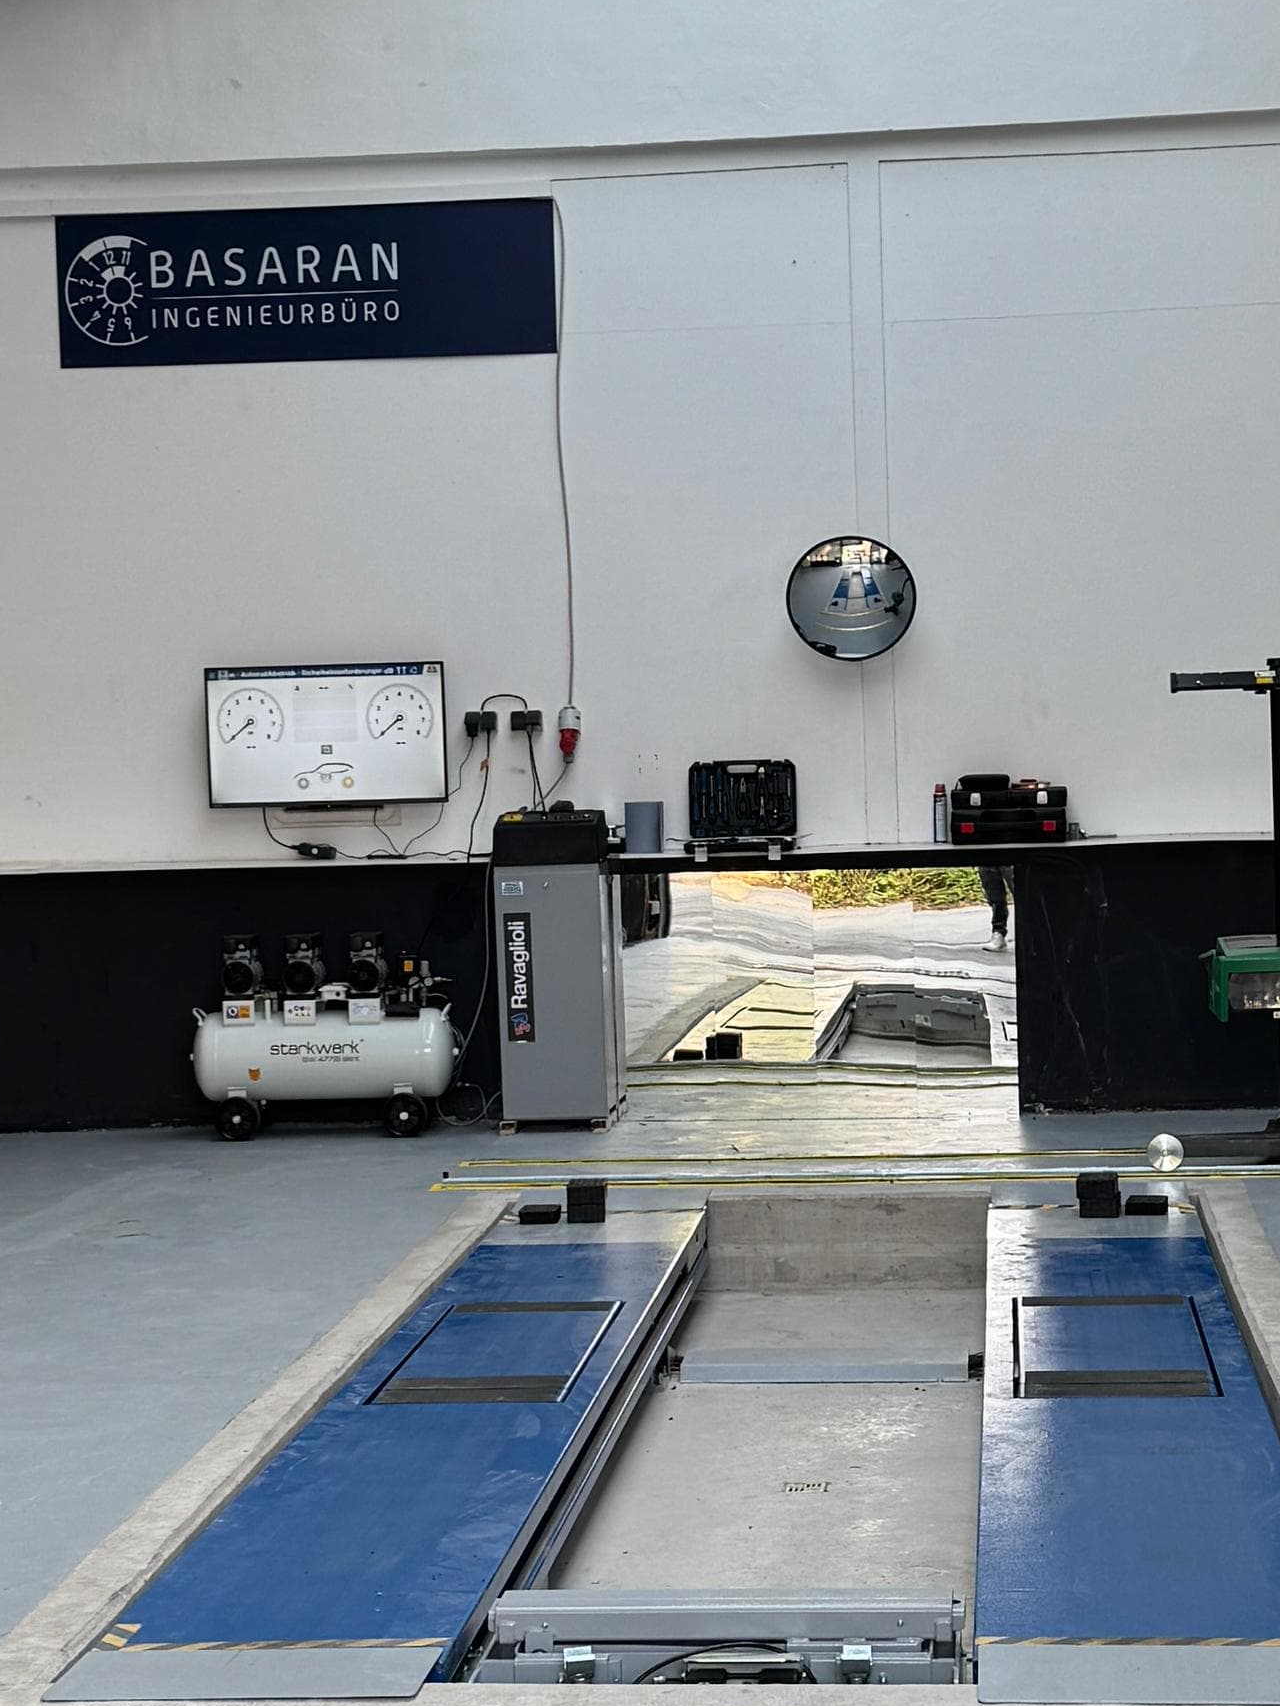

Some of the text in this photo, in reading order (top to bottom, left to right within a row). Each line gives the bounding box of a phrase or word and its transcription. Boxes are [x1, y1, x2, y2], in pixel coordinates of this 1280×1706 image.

[102, 250, 131, 266] 12 11
[150, 241, 399, 289] BASARAN
[79, 278, 94, 288] 2
[79, 295, 94, 305] 3
[89, 310, 101, 322] 4
[151, 297, 400, 329] INGENIEURBÜRO
[106, 316, 132, 332] 5 6
[507, 921, 530, 1010] Ravaglioli
[269, 1039, 360, 1056] starkwerk
